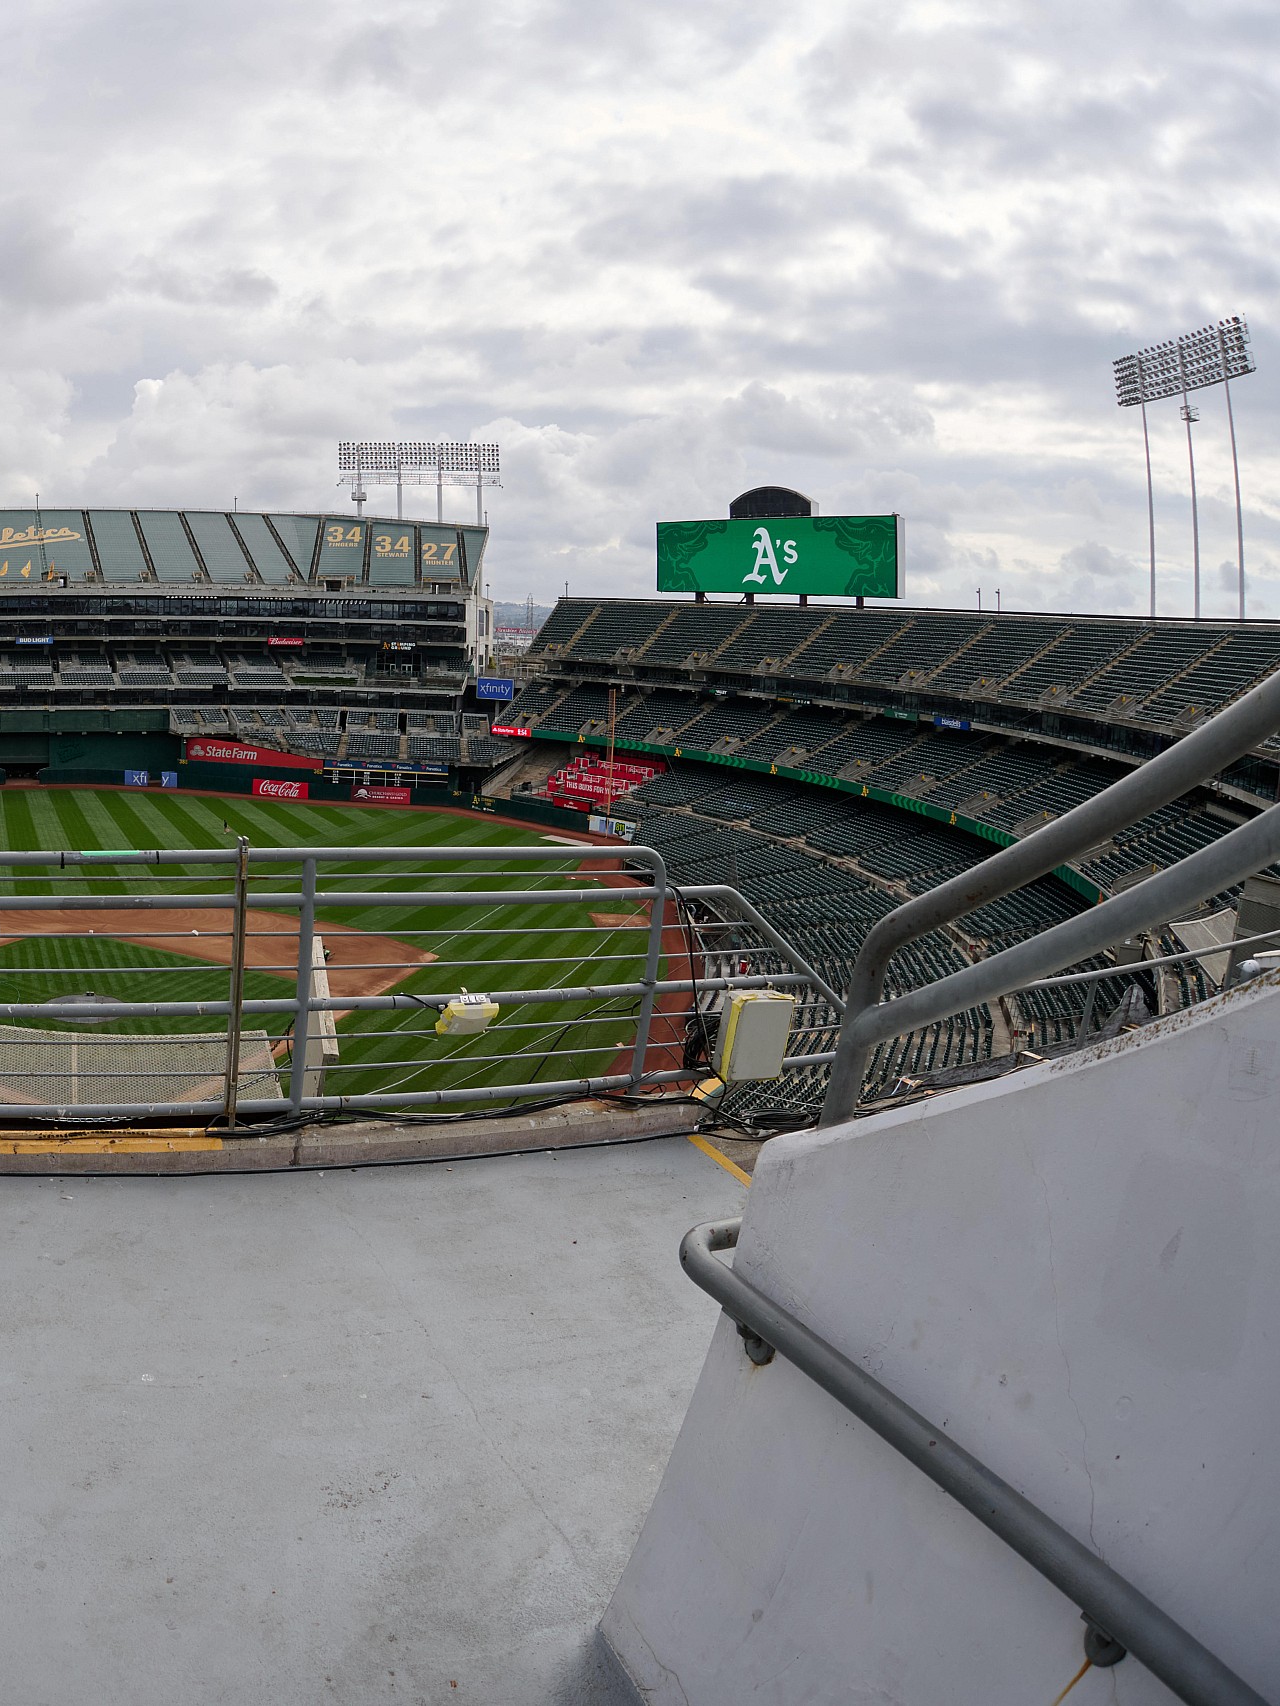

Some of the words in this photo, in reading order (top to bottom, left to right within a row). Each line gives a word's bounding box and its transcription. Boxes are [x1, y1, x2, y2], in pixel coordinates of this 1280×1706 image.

[327, 527, 362, 543] 34
[375, 536, 411, 553] 34
[422, 543, 457, 560] 27
[742, 527, 798, 585] A's
[480, 683, 510, 696] xfinity
